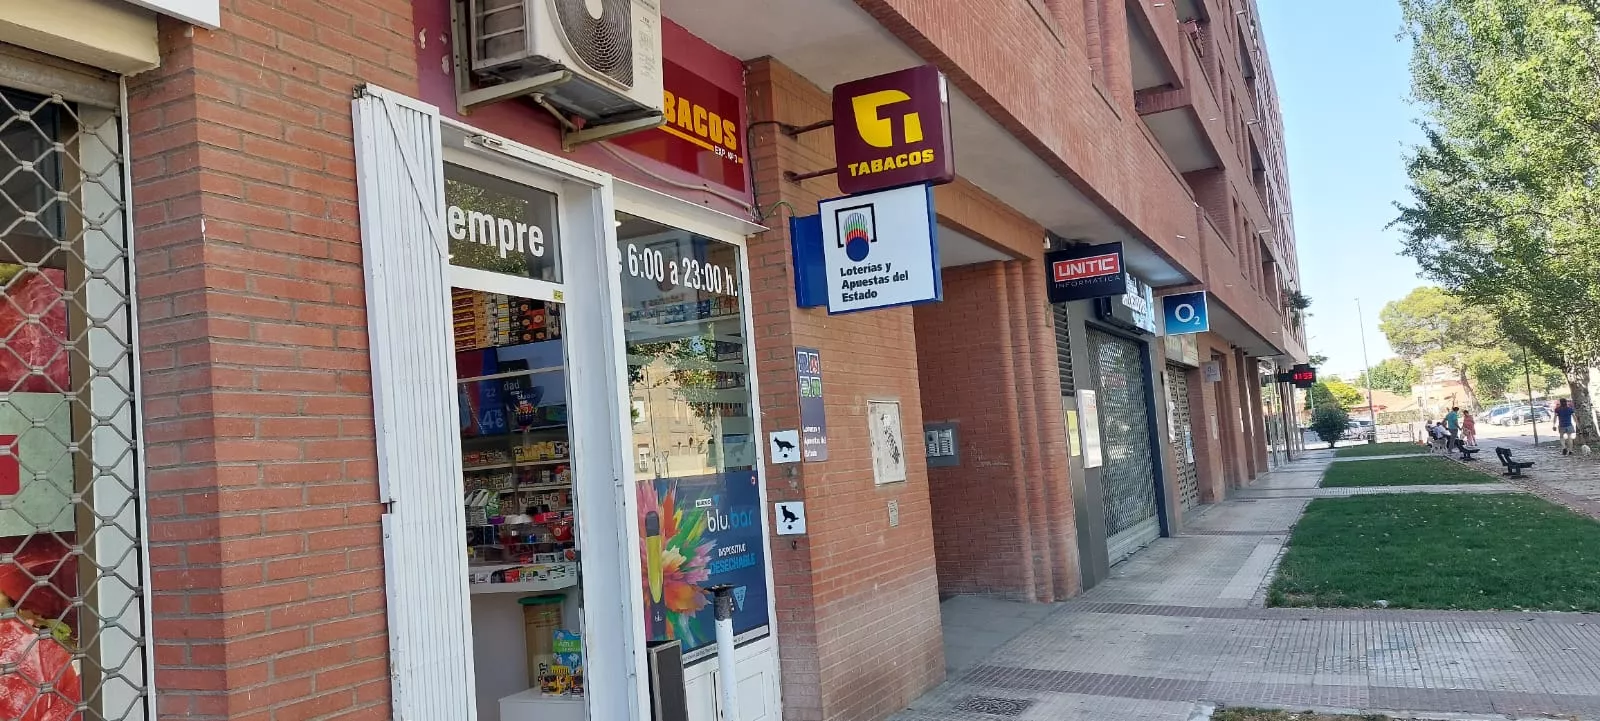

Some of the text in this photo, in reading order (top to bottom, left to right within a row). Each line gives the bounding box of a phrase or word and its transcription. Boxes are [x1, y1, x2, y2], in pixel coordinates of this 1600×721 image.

[848, 148, 935, 177] TABACOS
[627, 243, 665, 282] 6:00
[669, 260, 679, 286] a
[682, 257, 721, 294] 23:00
[725, 266, 738, 297] h.
[840, 261, 892, 278] Loterías y
[1058, 257, 1115, 277] UNITIC
[841, 270, 909, 291] Apuestas del
[1055, 275, 1121, 289] INFORMATICA
[842, 290, 878, 303] Estado
